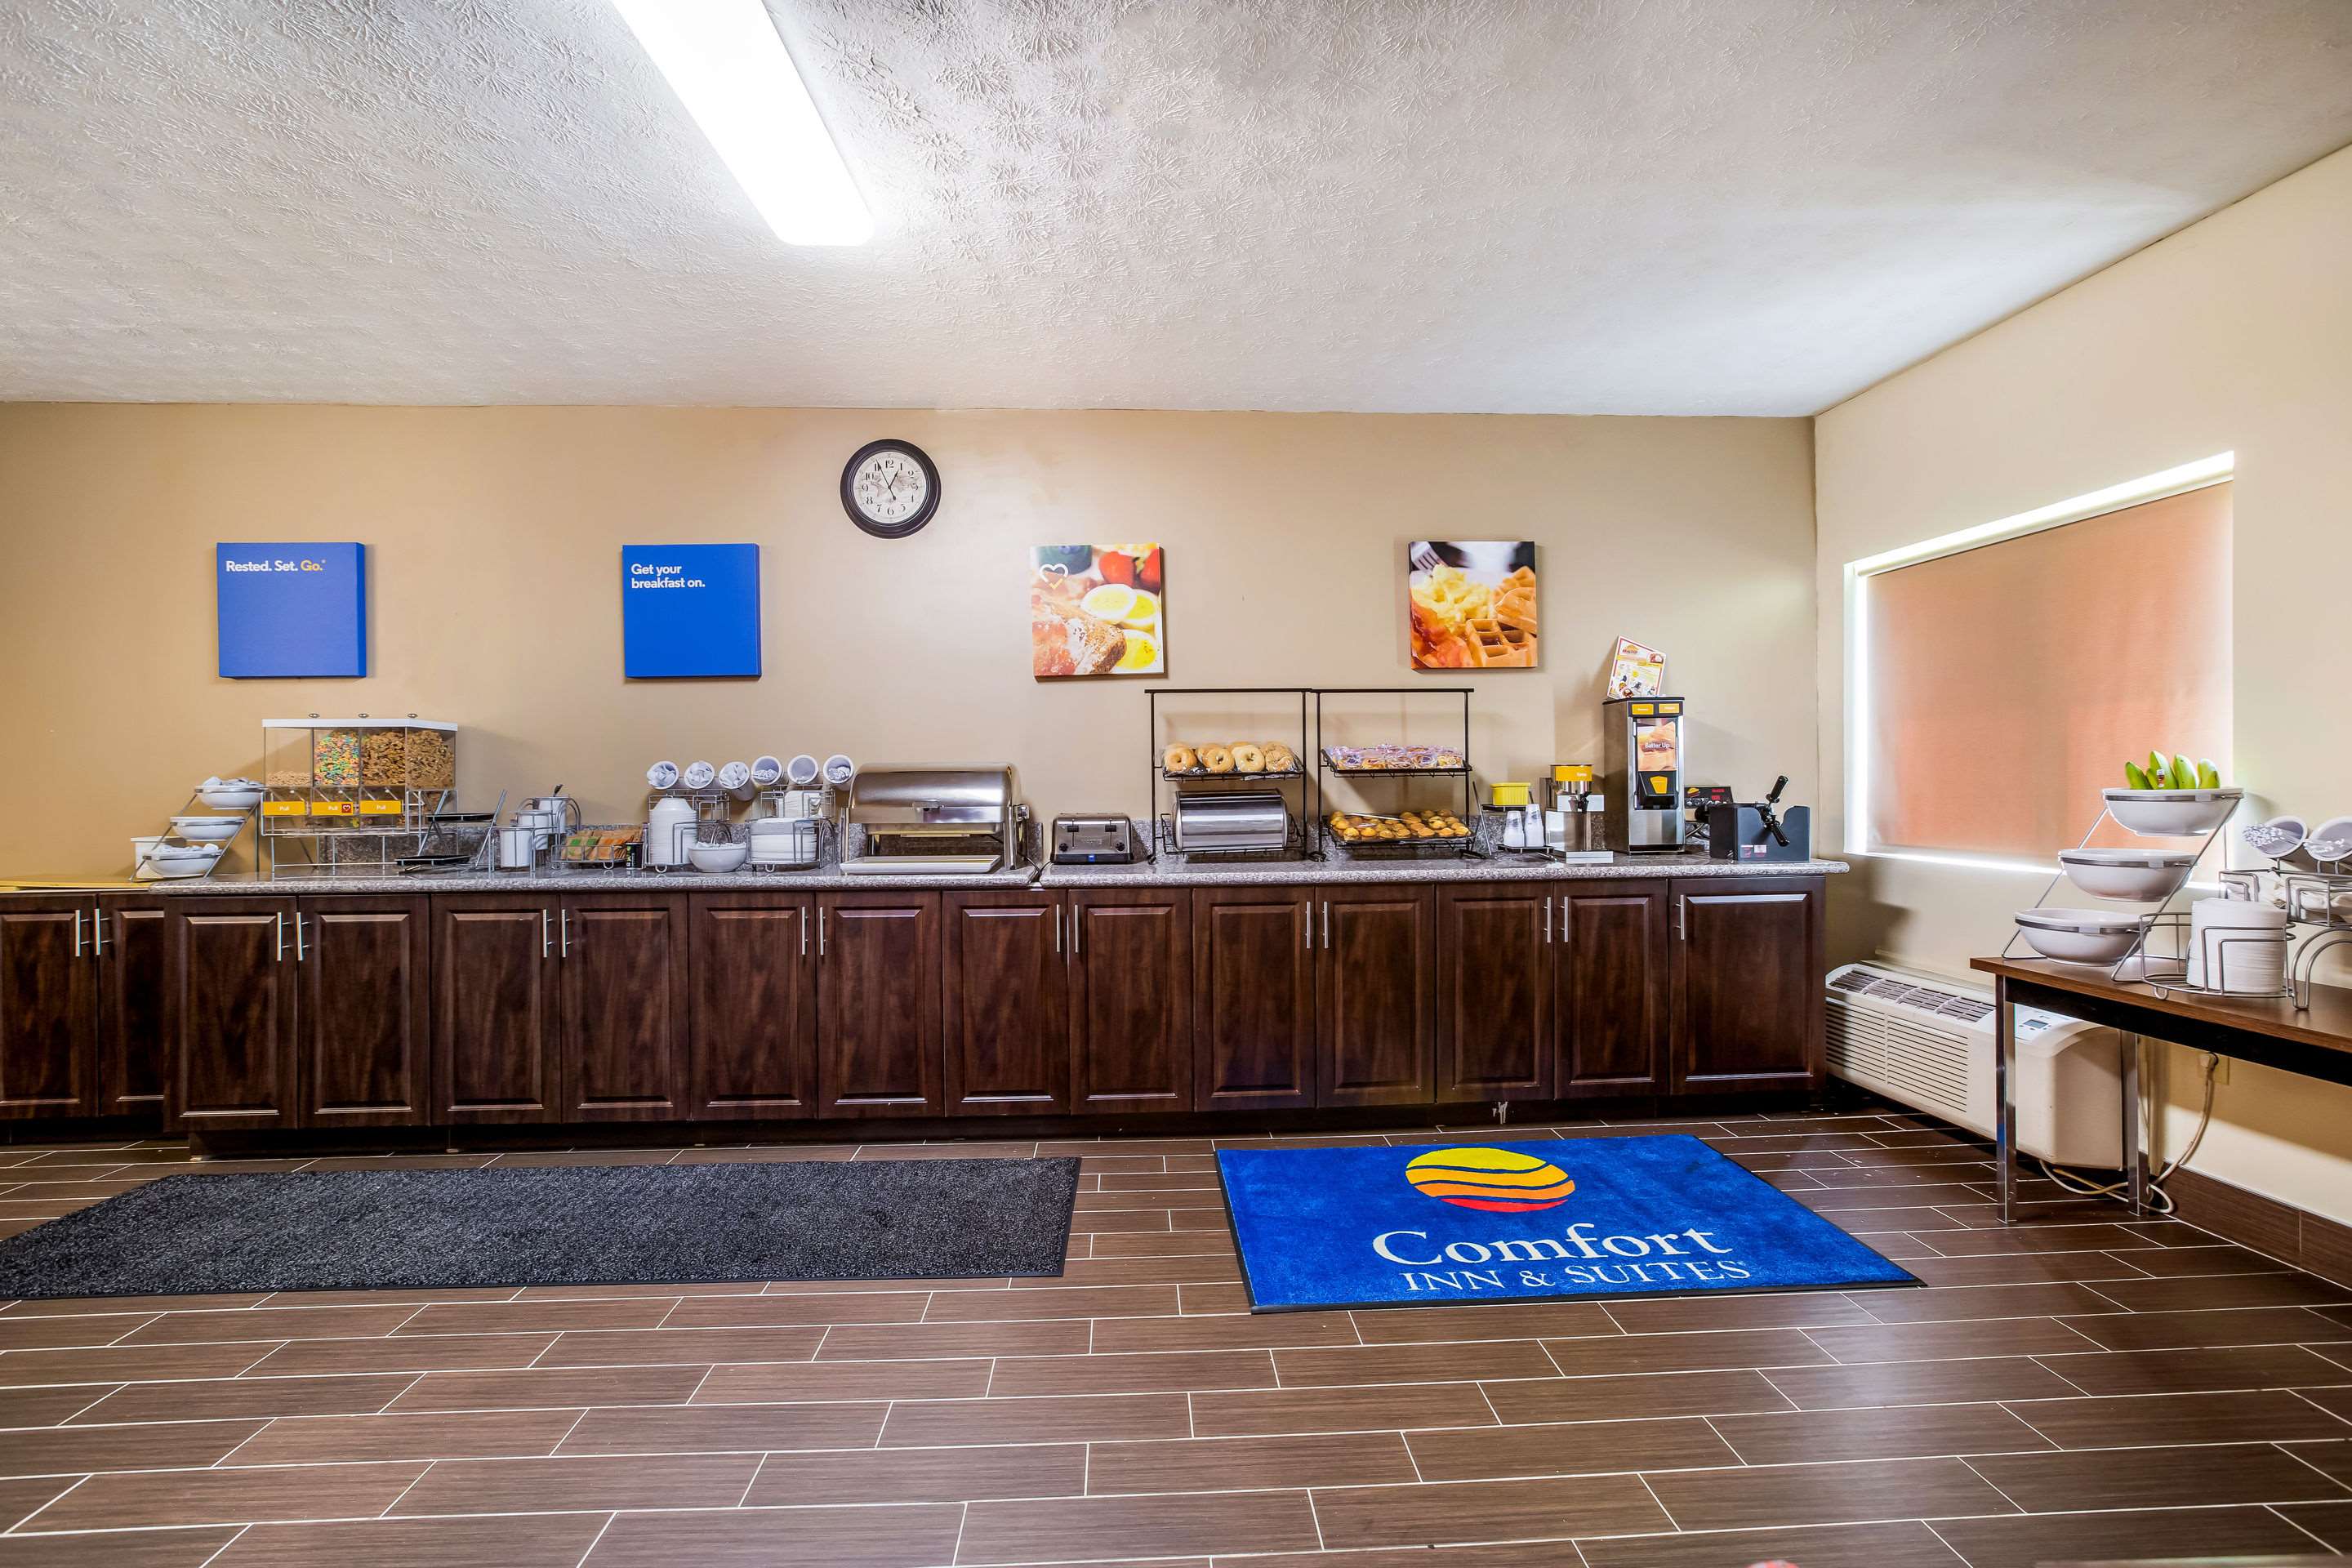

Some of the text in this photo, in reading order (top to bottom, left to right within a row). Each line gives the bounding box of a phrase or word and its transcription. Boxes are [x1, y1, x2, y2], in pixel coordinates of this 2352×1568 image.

[885, 460, 894, 469] 12
[225, 560, 272, 572] Rested.
[274, 560, 298, 572] Set.
[631, 564, 682, 577] Get your
[631, 577, 685, 588] breakfast
[1372, 1223, 1733, 1265] Comfort
[1399, 1261, 1751, 1291] INN & SUITES
